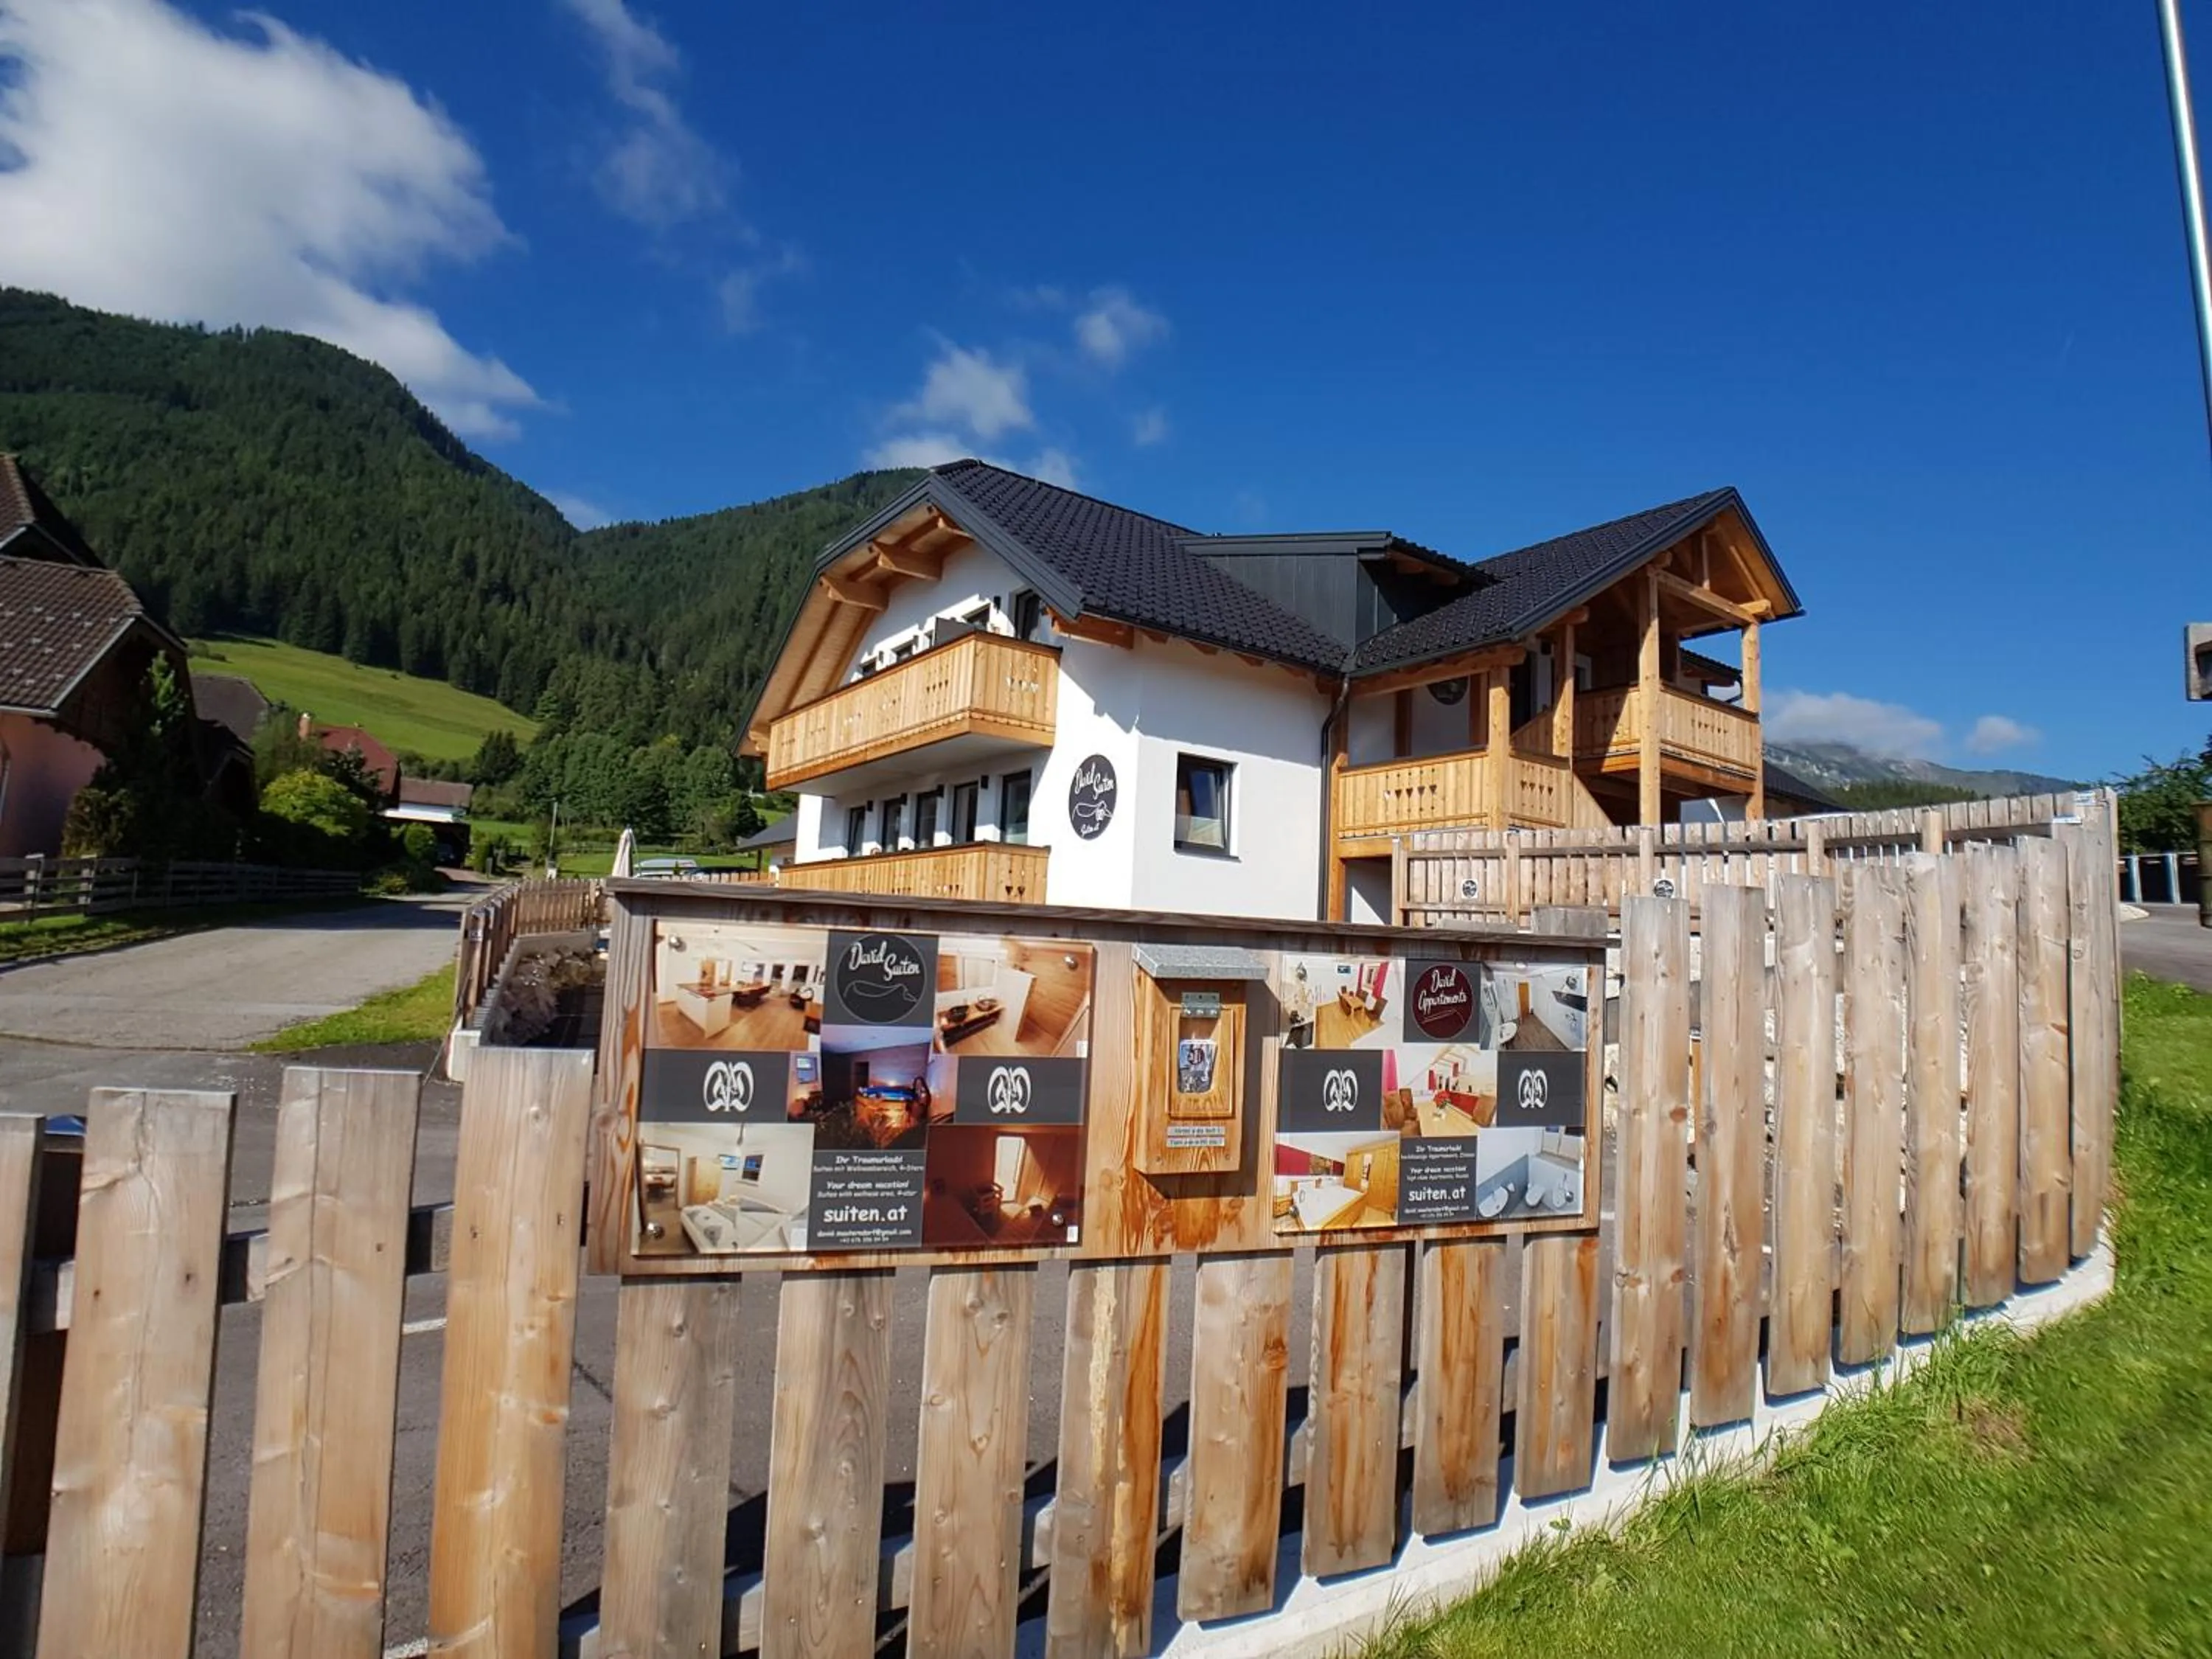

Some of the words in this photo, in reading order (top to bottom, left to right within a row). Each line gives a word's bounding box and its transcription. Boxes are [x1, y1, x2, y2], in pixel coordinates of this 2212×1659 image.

[849, 941, 887, 970] David
[883, 953, 920, 981] Suiten
[1430, 968, 1456, 993] David
[1408, 1185, 1467, 1202] suiten.at
[823, 1205, 908, 1223] suiten.at
